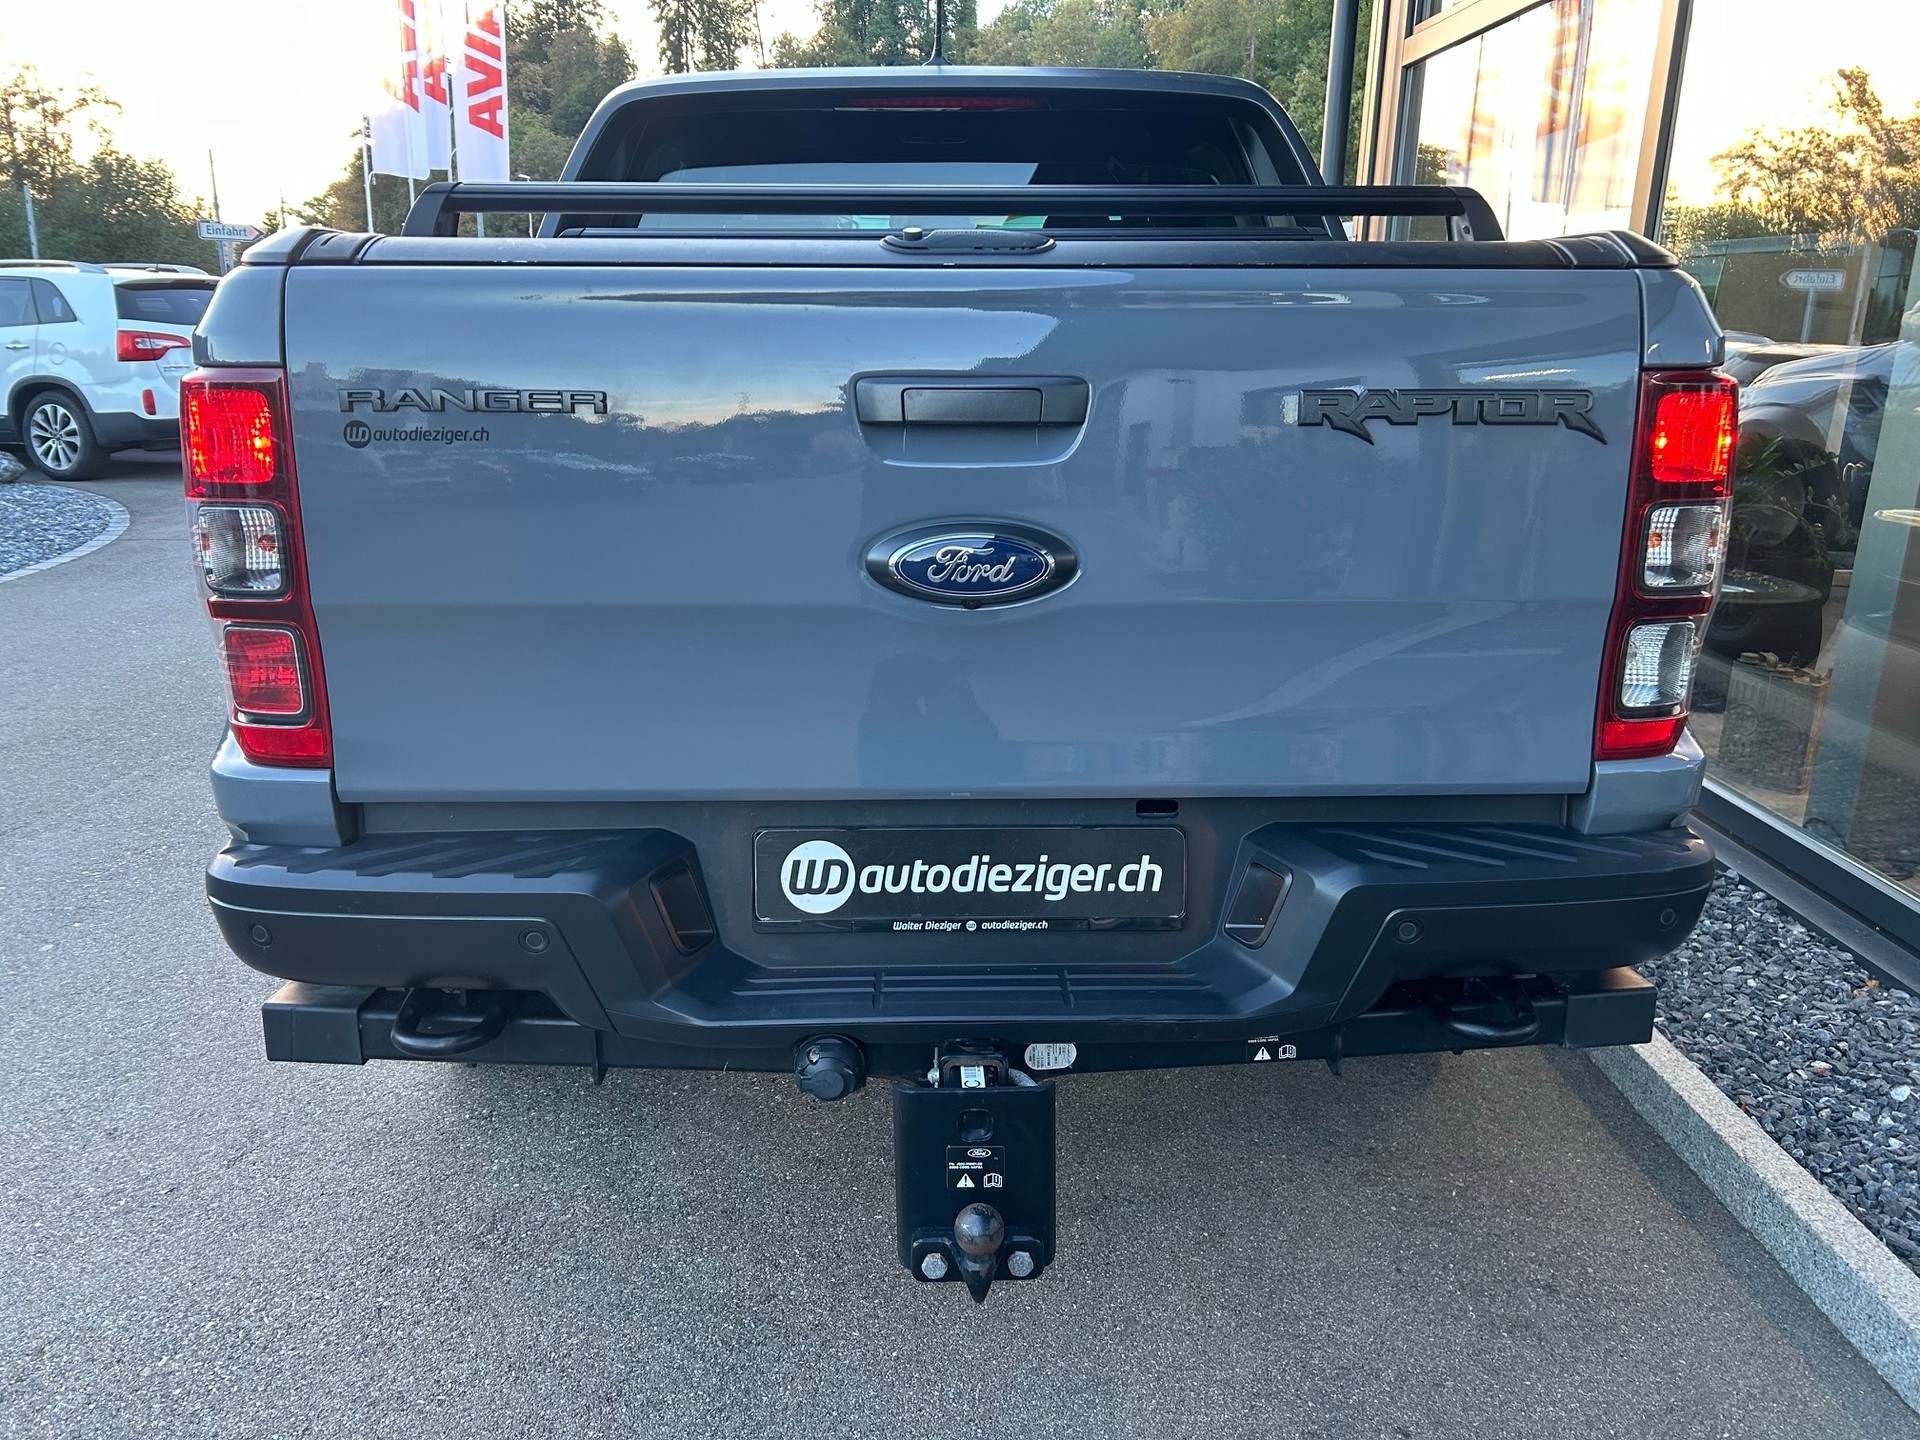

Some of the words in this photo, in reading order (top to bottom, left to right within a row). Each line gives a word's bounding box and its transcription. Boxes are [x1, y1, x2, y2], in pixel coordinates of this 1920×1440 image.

[206, 225, 248, 237] Einfahrt
[338, 388, 608, 415] RANGER
[1298, 389, 1607, 445] RAPTOR
[373, 426, 490, 445] autodieziger.ch
[927, 545, 1017, 583] Ford
[858, 854, 1163, 901] autodieziger.ch
[892, 921, 923, 931] Walter
[925, 920, 962, 932] Dieziger
[981, 920, 1049, 932] autodieziger.ch
